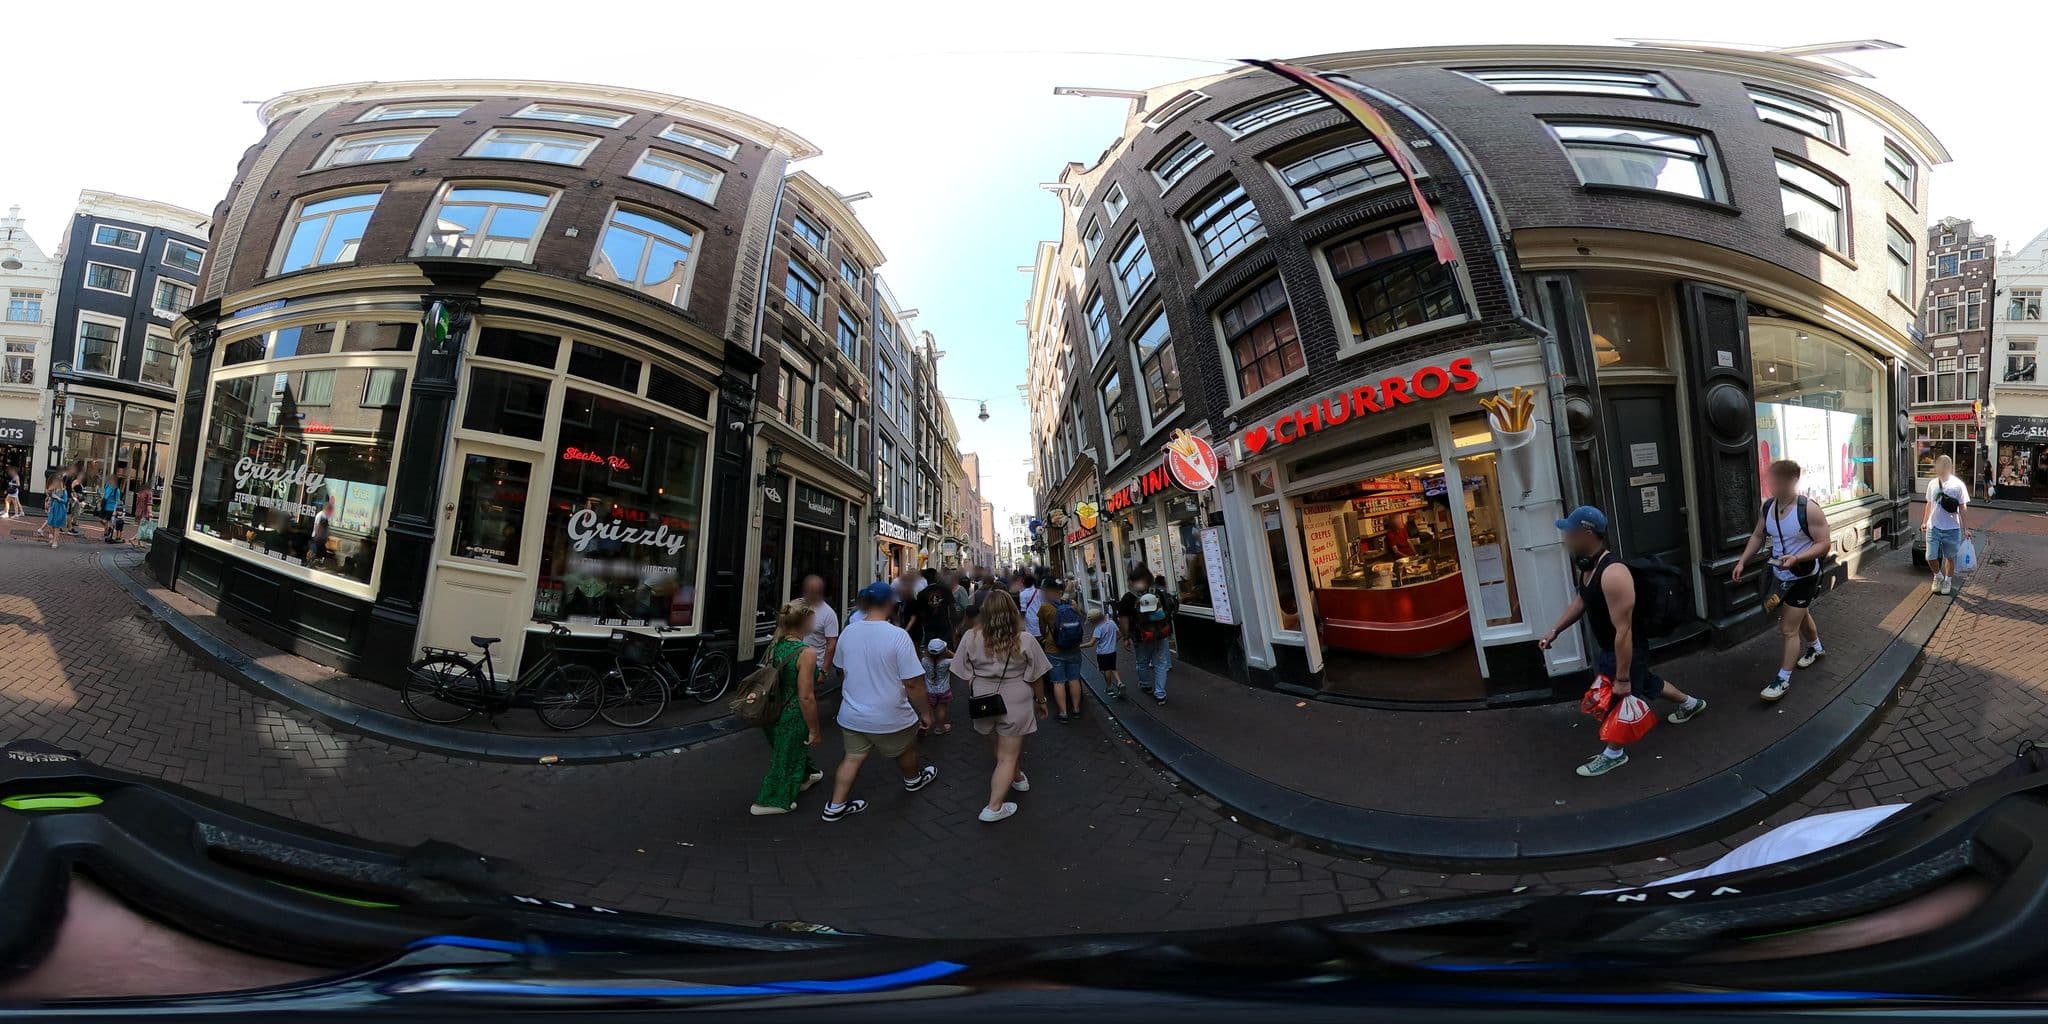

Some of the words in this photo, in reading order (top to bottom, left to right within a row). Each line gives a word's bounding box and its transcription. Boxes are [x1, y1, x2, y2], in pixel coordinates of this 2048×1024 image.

[1273, 357, 1479, 444] CHURROS
[2030, 426, 2048, 437] SH
[234, 456, 326, 494] Grizzly
[1106, 487, 1130, 513] WOK
[567, 508, 686, 556] Grizzly
[879, 518, 905, 540] BURGER
[1312, 552, 1338, 567] WAFFLES
